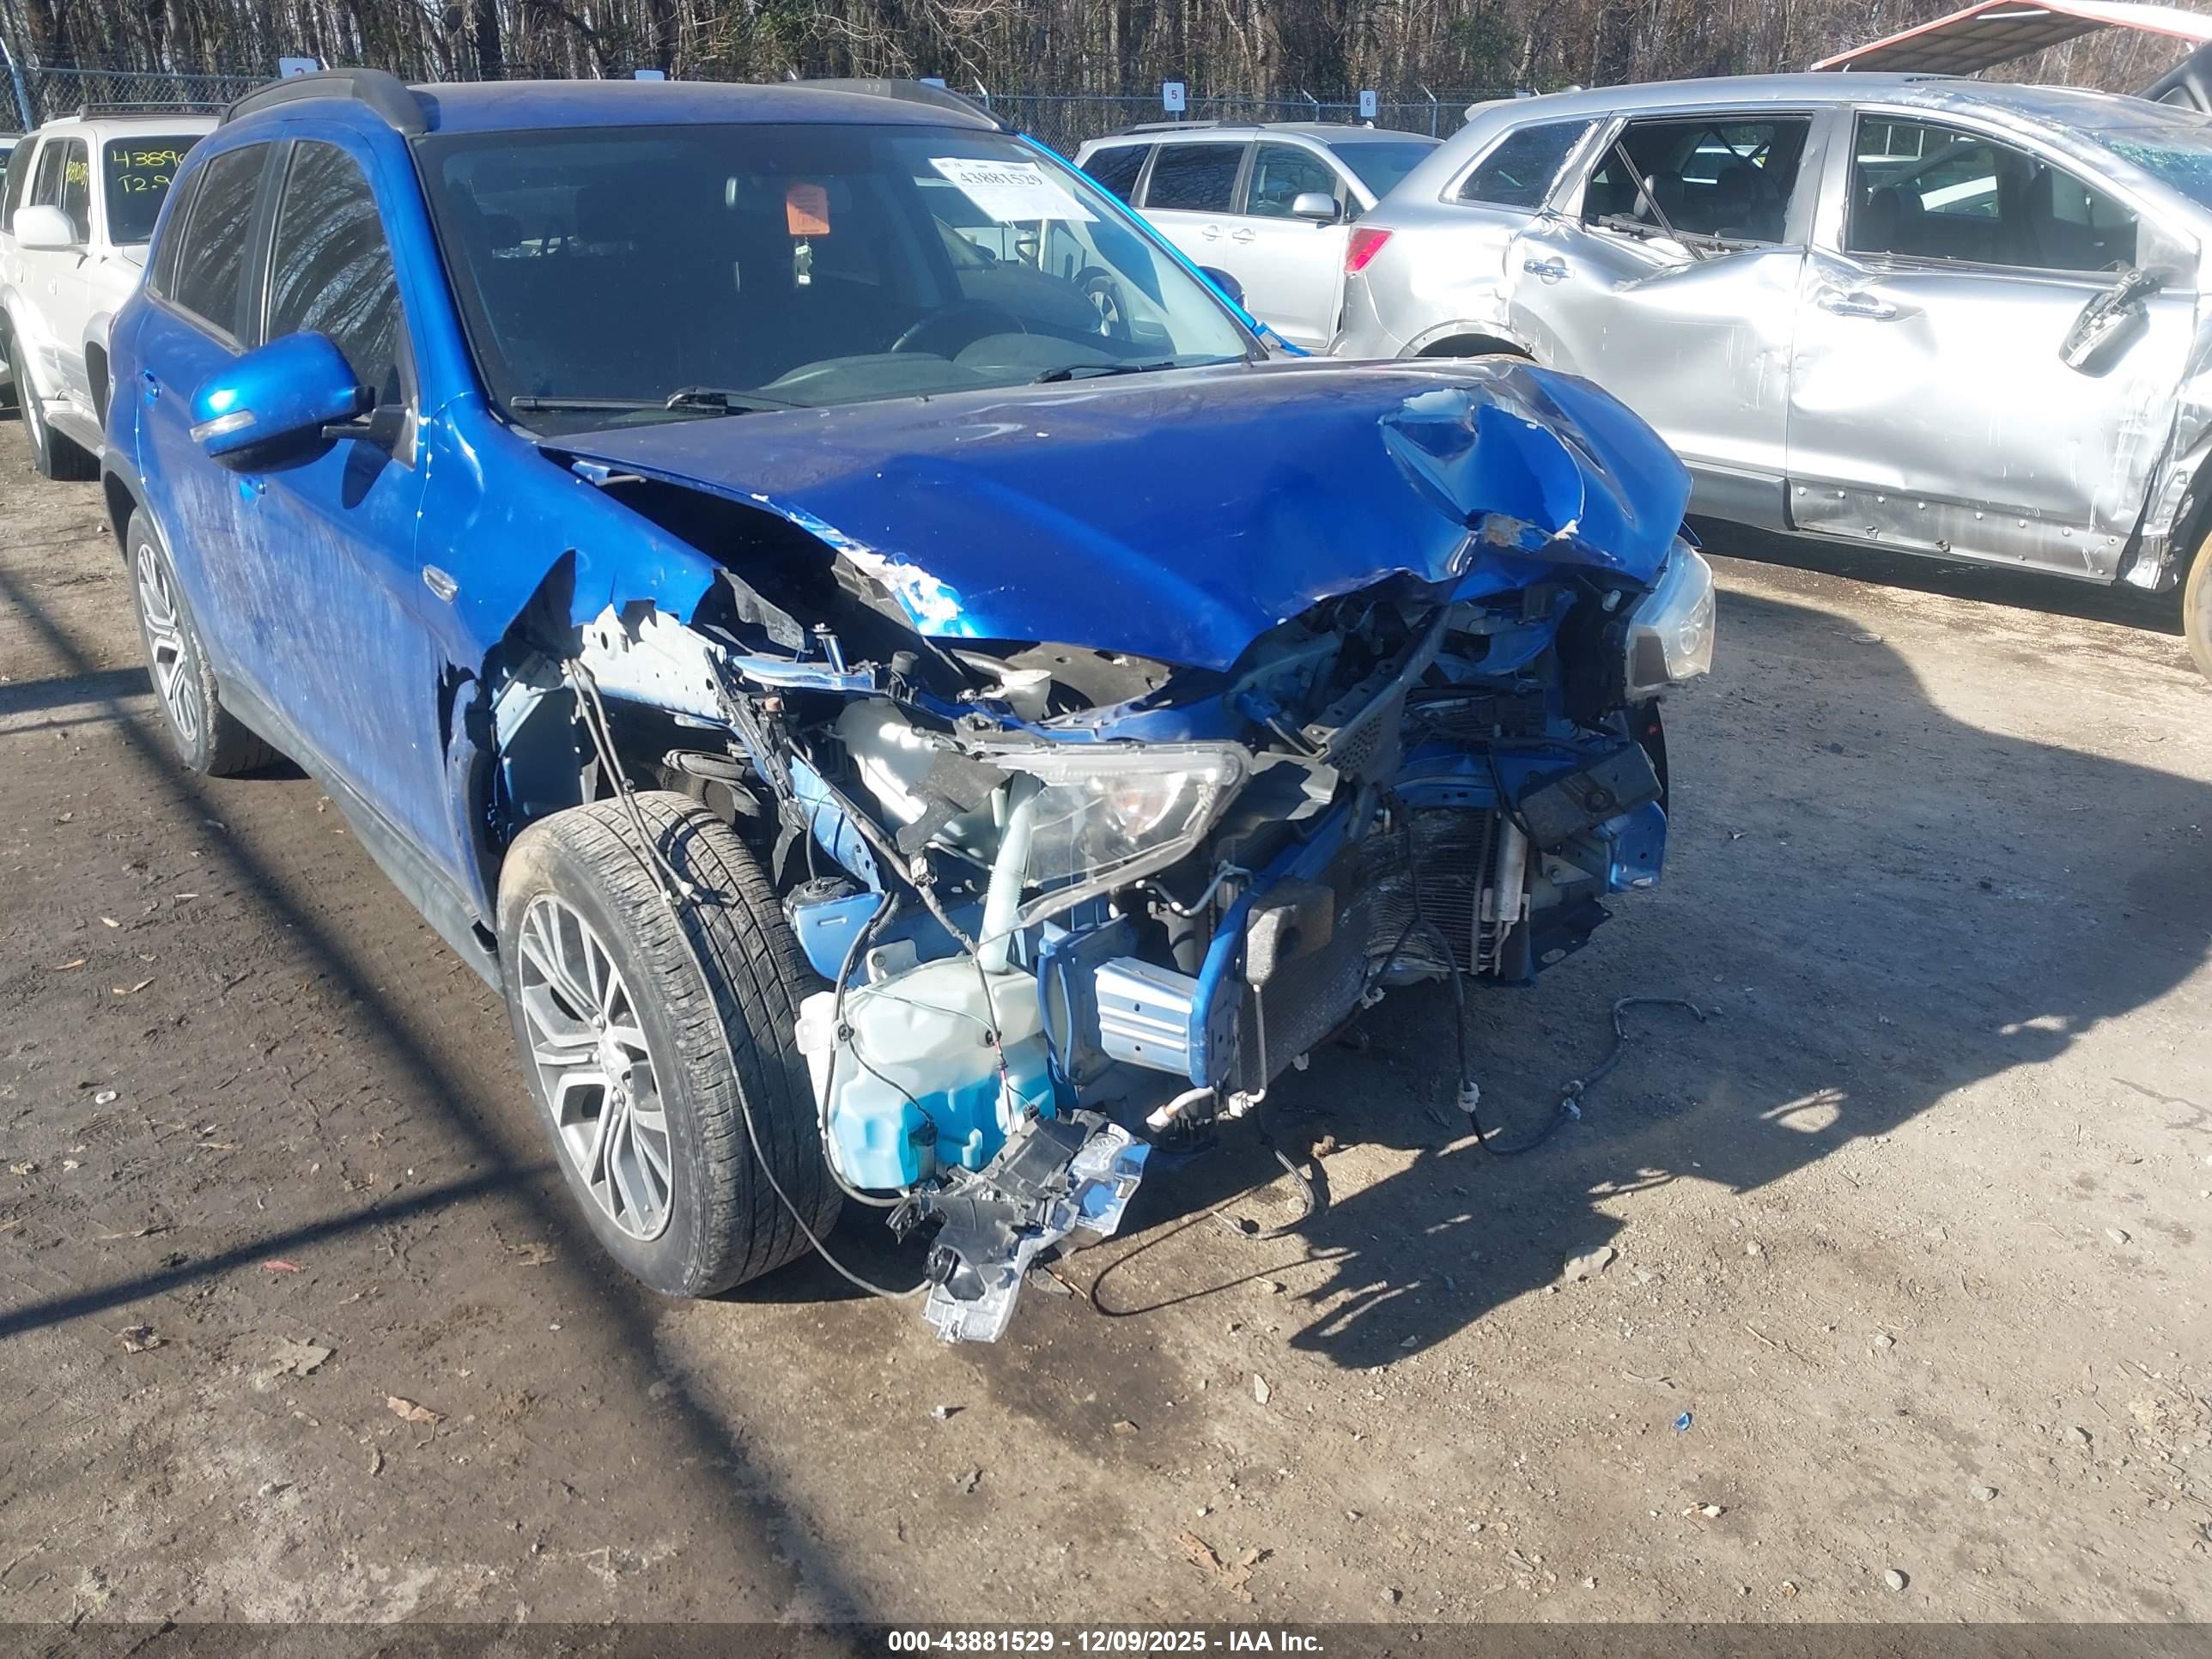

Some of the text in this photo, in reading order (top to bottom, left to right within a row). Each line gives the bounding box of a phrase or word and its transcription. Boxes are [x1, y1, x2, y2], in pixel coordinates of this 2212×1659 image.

[1170, 88, 1178, 100] 5
[1365, 96, 1371, 106] 6
[960, 171, 1043, 185] 43881529
